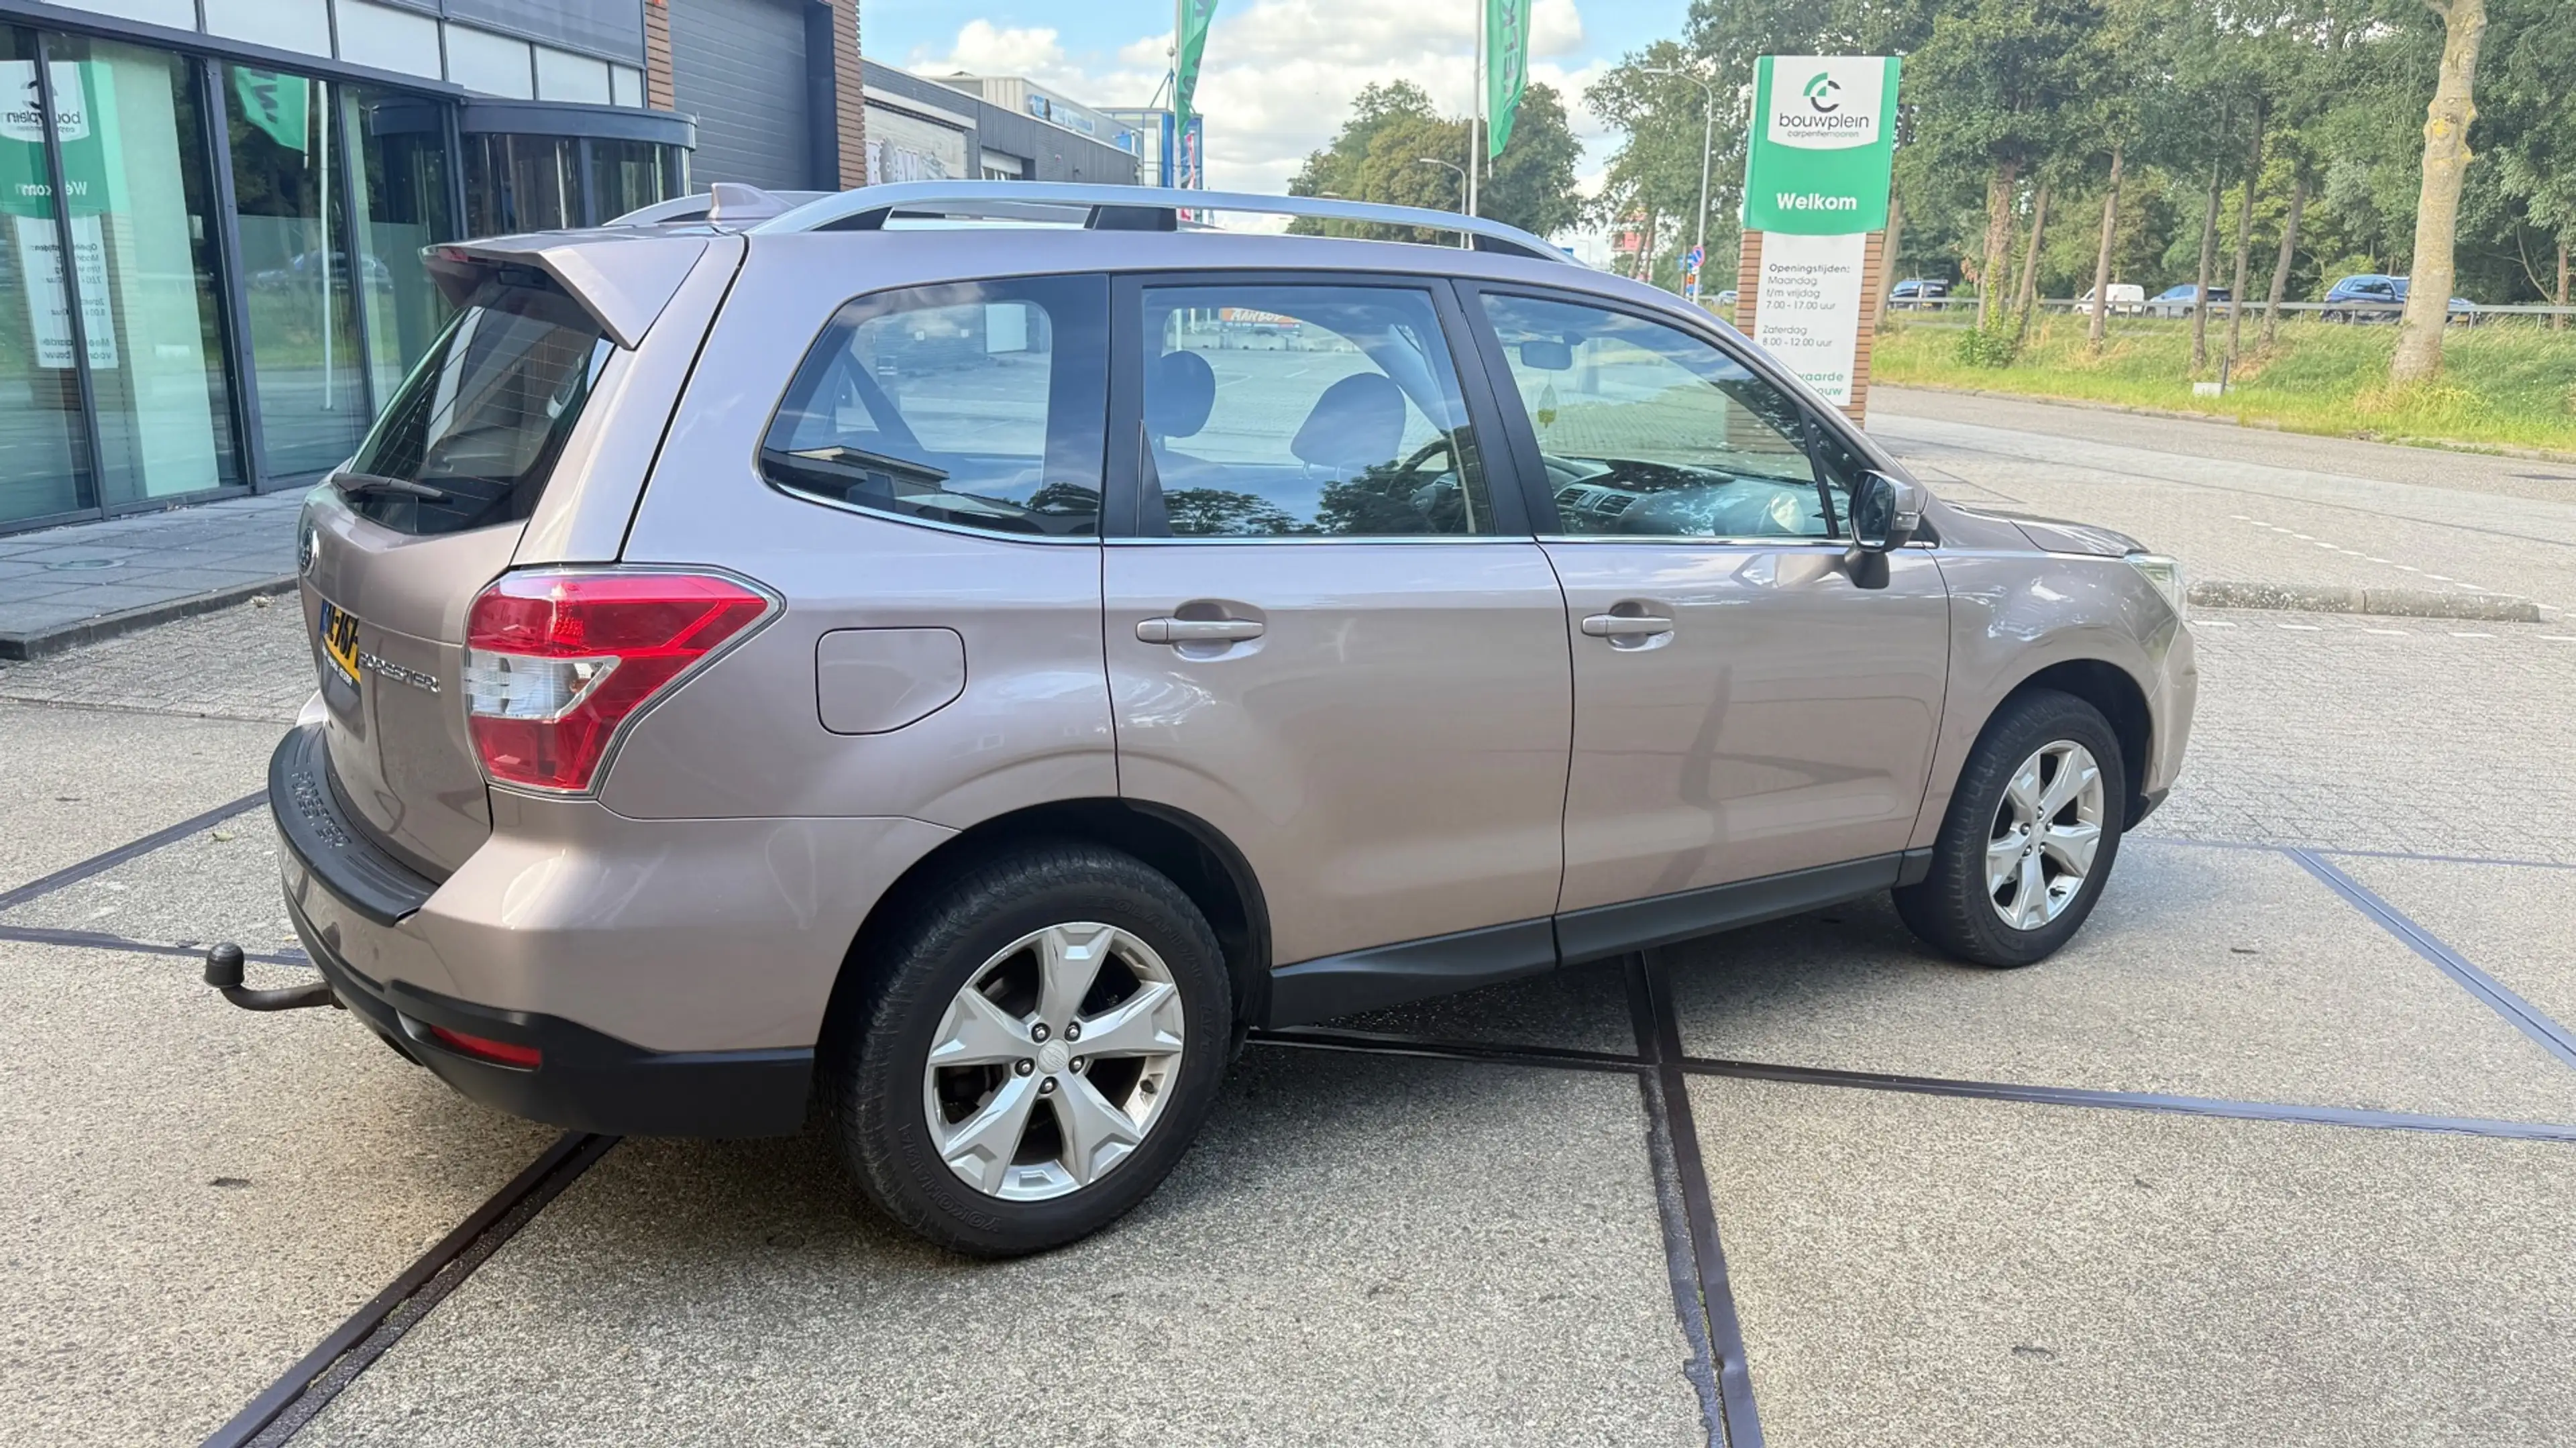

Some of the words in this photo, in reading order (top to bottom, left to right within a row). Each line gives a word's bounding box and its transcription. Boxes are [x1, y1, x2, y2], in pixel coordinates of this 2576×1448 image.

[1779, 113, 1869, 130] bouwplein
[1776, 192, 1857, 210] Welkom
[1769, 263, 1850, 274] Openingstijden:
[1768, 276, 1817, 287] Maandag
[1766, 288, 1784, 297] t/m
[1786, 289, 1820, 299] vrijdag
[1763, 325, 1807, 336] Zaterdag
[898, 1123, 1002, 1233] YOKOHAMA
